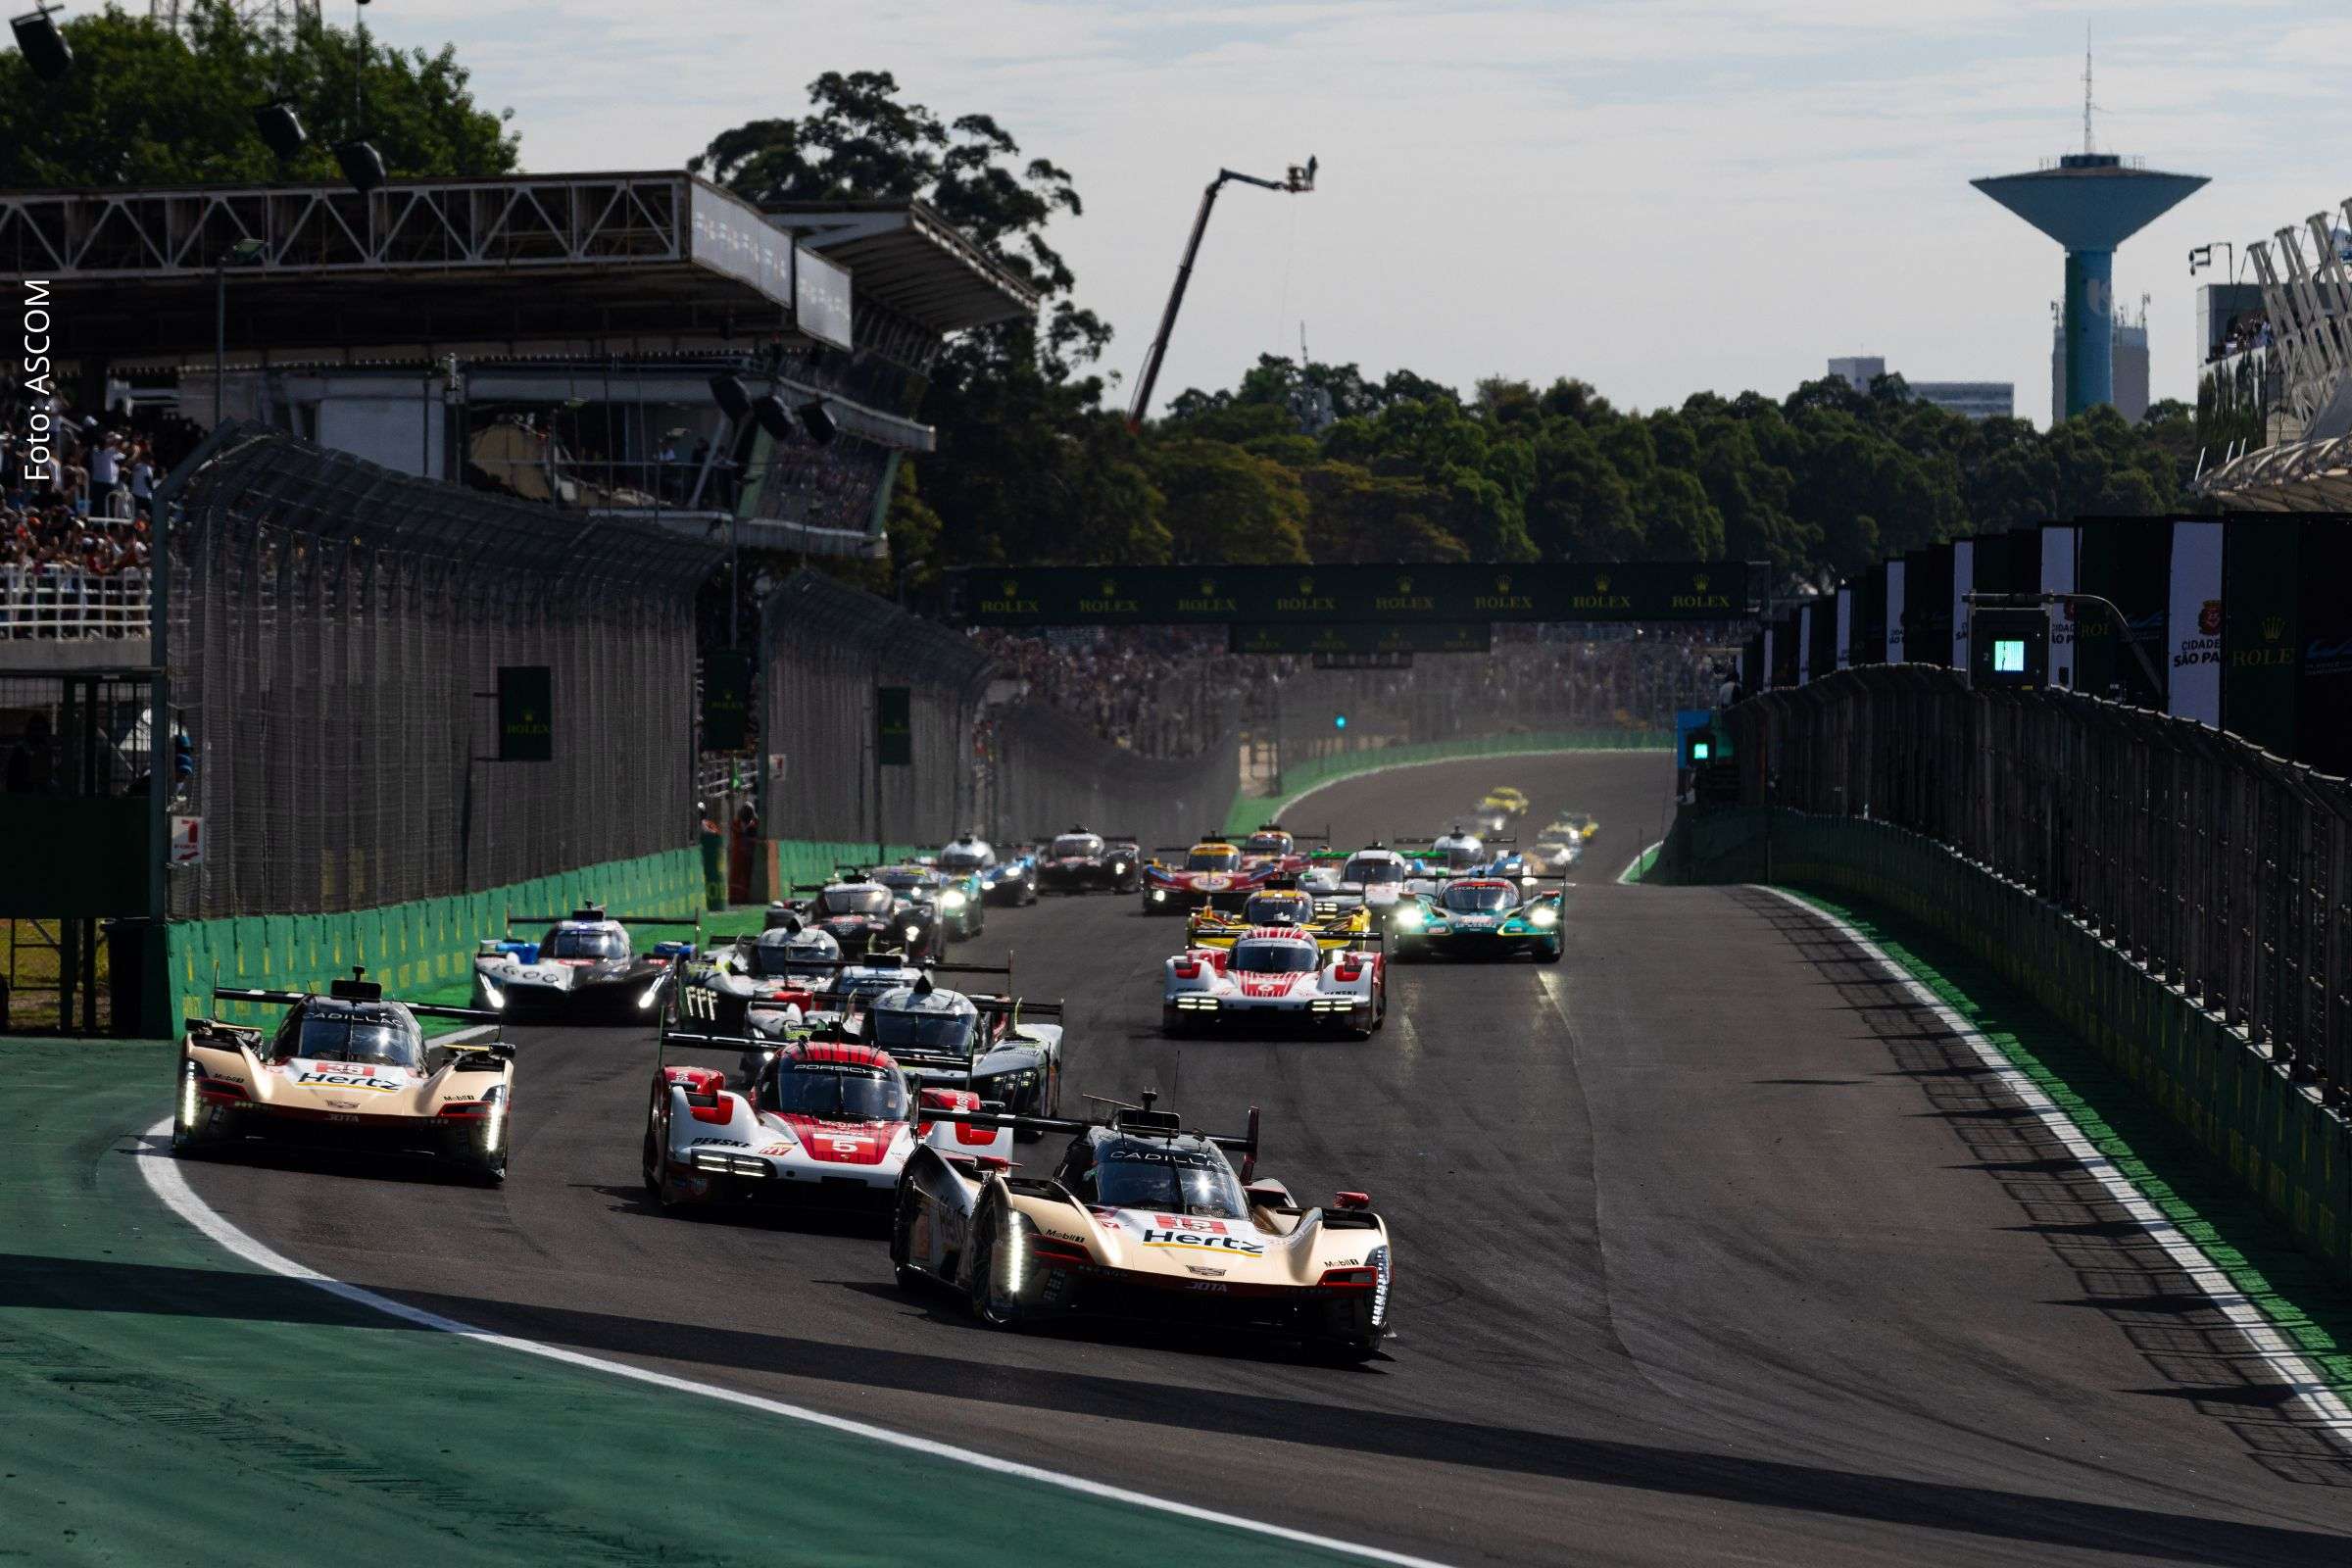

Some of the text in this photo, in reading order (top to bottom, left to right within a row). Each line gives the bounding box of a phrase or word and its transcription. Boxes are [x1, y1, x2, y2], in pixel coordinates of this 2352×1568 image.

[982, 599, 1040, 612] ROLEX
[1080, 599, 1139, 612] ROLEX
[1178, 598, 1237, 612] ROLEX
[1277, 597, 1336, 612] ROLEX
[1375, 596, 1435, 611] ROLEX
[1474, 596, 1533, 610] ROLEX
[1573, 595, 1631, 609] ROLEX
[1670, 595, 1731, 609] ROLEX
[2174, 651, 2198, 667] SÃO
[2232, 647, 2297, 667] ROLE
[298, 1072, 404, 1091] Hertz
[690, 1137, 752, 1148] PENSKE
[831, 1137, 858, 1152] 5
[1110, 1151, 1229, 1170] CADILLAC
[1143, 1229, 1265, 1253] Hertz
[1184, 1281, 1228, 1293] JOTA
